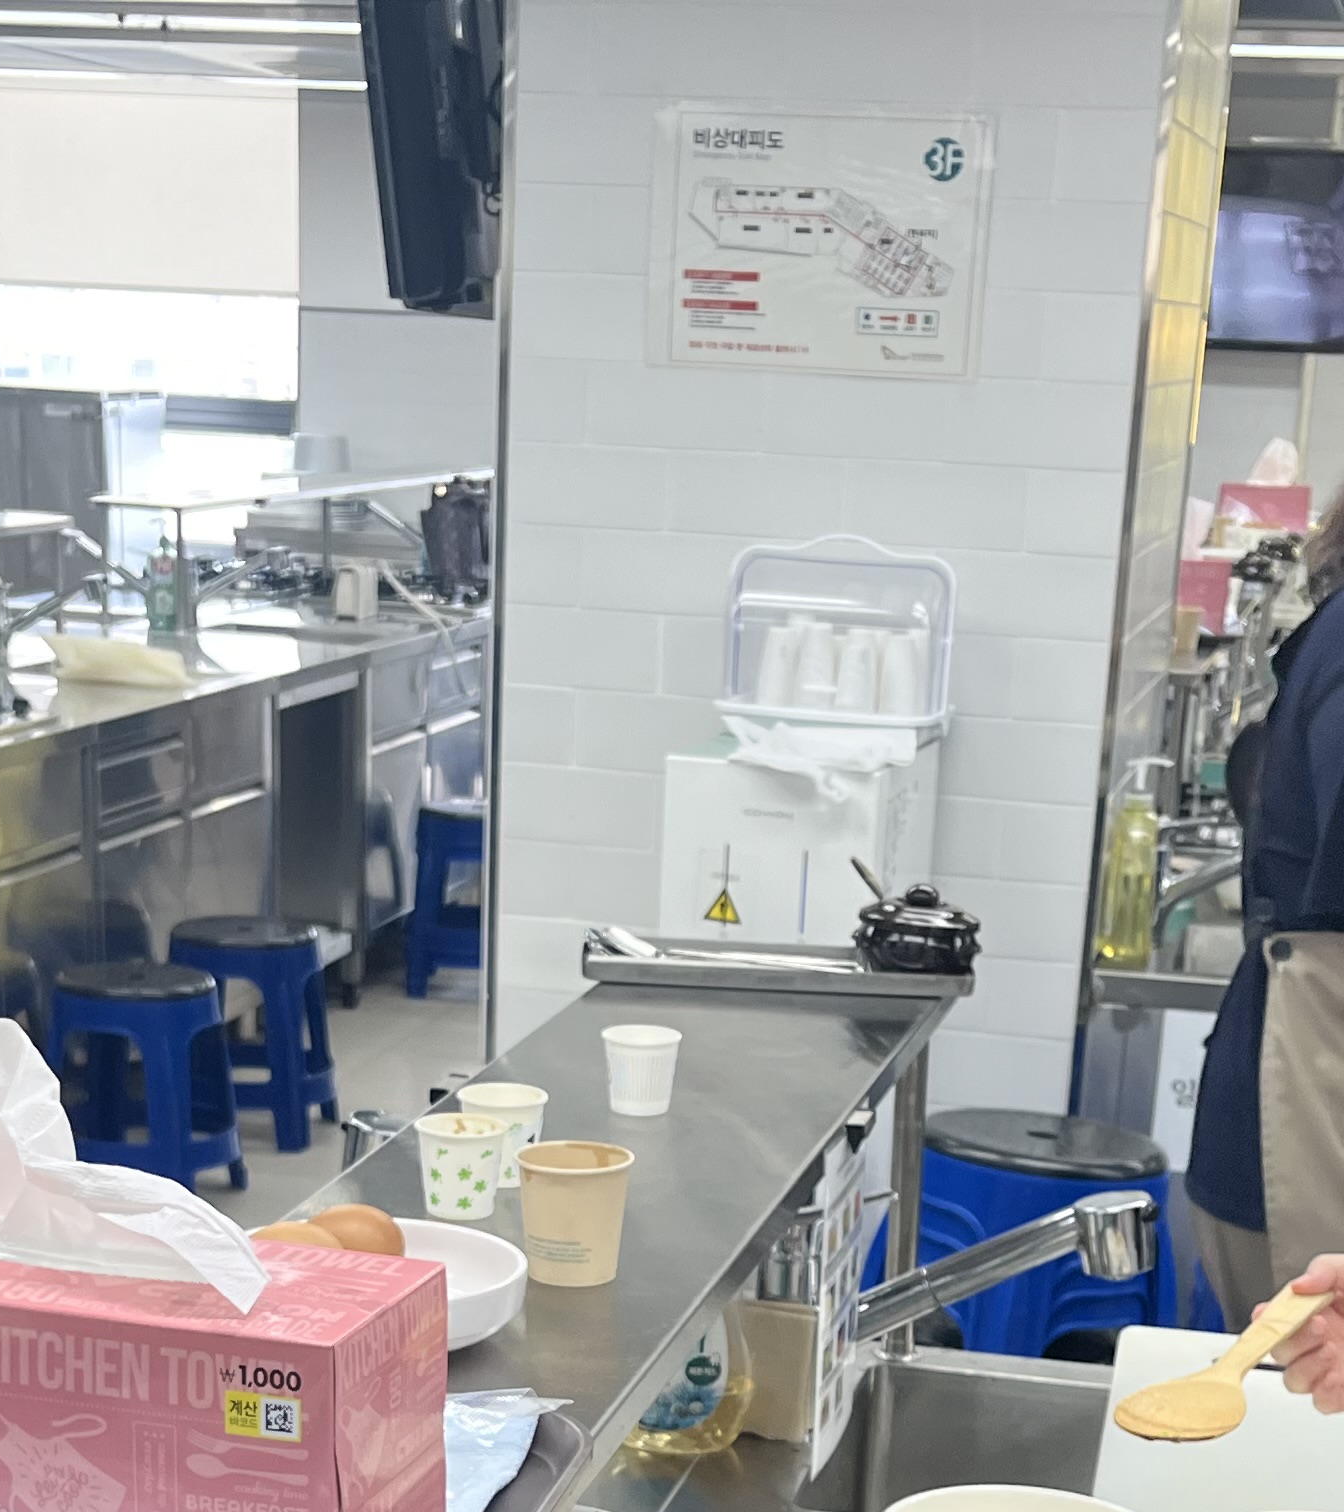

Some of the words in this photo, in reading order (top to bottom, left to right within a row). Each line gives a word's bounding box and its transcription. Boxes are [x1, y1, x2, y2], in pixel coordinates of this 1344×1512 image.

[693, 128, 785, 149] 비상대피도
[922, 140, 966, 177] 3F
[278, 1247, 404, 1277] TOWEL
[229, 1399, 258, 1418] 계산
